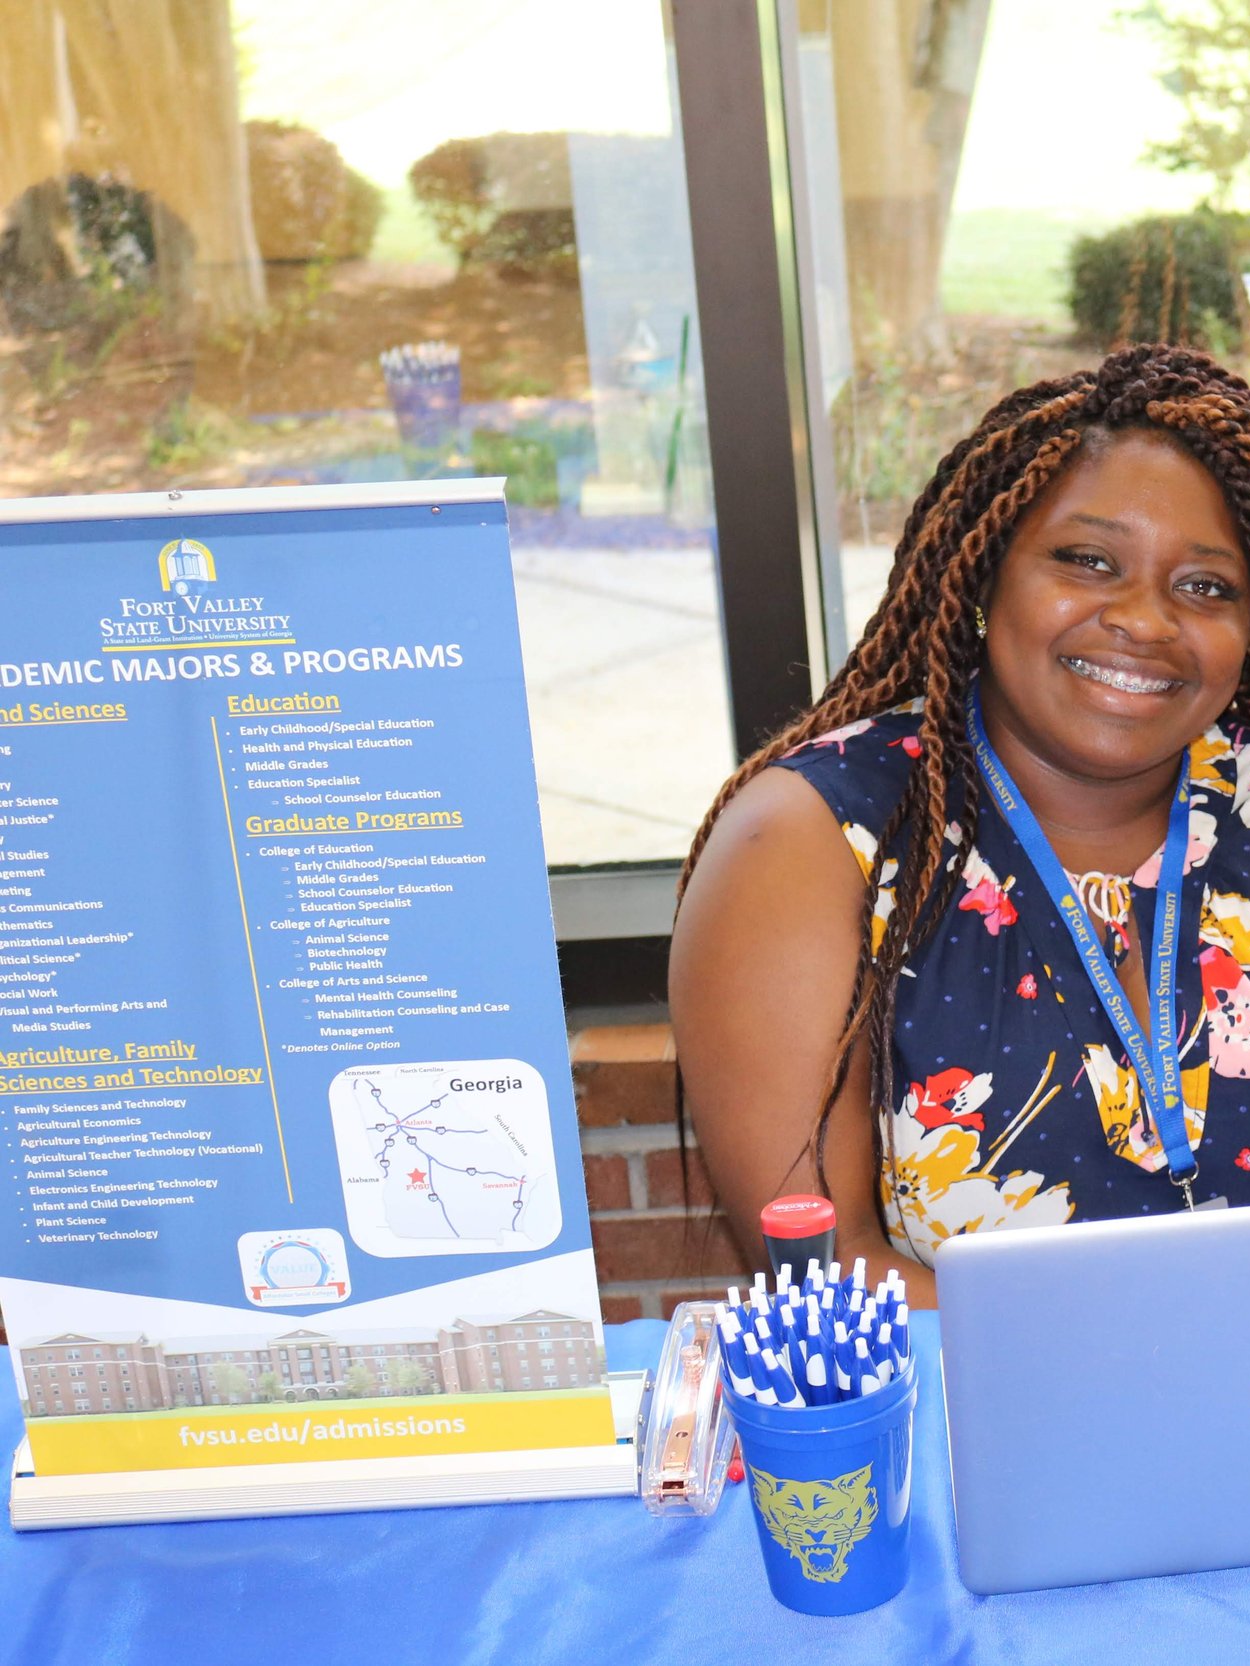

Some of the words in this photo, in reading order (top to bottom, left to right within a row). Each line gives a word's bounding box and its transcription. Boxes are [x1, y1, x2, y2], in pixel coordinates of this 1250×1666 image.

[120, 598, 176, 617] FORT
[181, 595, 264, 614] VALLEY
[100, 618, 161, 637] STATE
[165, 615, 290, 634] UNIVERSITY
[0, 659, 104, 688] DEMIC
[112, 653, 241, 682] MAJORS
[250, 652, 276, 676] &
[284, 643, 464, 674] PROGRAMS
[227, 692, 340, 714] Education
[0, 704, 23, 722] nd
[29, 702, 126, 721] Sciences
[240, 724, 269, 738] Early
[271, 720, 375, 735] Childhood/Special
[377, 717, 434, 730] Education
[242, 742, 281, 754] Health
[283, 741, 305, 752] and
[308, 739, 353, 753] Physical
[356, 737, 413, 749] Education
[245, 760, 285, 772] Middle
[288, 759, 329, 770] Grades
[248, 777, 304, 790] Education
[306, 775, 361, 788] Specialist
[976, 741, 1017, 811] UNIVERSITY
[16, 797, 59, 807] Science
[284, 793, 323, 805] School
[325, 791, 382, 803] Counselor
[385, 789, 441, 800] Education
[245, 813, 349, 834] Graduate
[356, 809, 463, 831] Programs
[8, 851, 49, 861] Studies
[259, 845, 301, 858] College
[303, 844, 316, 855] of
[318, 843, 374, 854] Education
[294, 860, 322, 872] Early
[325, 855, 427, 870] Childhood/Special
[430, 854, 486, 865] Education
[297, 873, 336, 885] Middle
[339, 872, 379, 883] Grades
[298, 887, 335, 899] School
[338, 885, 394, 897] Counselor
[398, 882, 453, 894] Education
[9, 901, 103, 913] Communications
[301, 901, 356, 913] Education
[358, 898, 412, 911] Specialist
[0, 920, 53, 931] thematics
[270, 918, 311, 931] College
[314, 917, 326, 928] of
[328, 915, 391, 929] Agriculture
[1158, 891, 1177, 958] UNIVERSITY
[0, 936, 64, 949] ganizational
[305, 933, 345, 945] Animal
[347, 931, 390, 943] Science
[0, 955, 30, 965] litical
[307, 946, 387, 959] Biotechnology
[309, 961, 343, 972] Public
[346, 959, 383, 970] Health
[1067, 908, 1090, 943] FORT
[1085, 944, 1114, 994] VALLEY
[1107, 995, 1132, 1034] STATE
[279, 977, 320, 989] College
[322, 976, 335, 987] of
[337, 975, 360, 986] Arts
[362, 974, 384, 985] and
[386, 973, 428, 984] Science
[1156, 960, 1171, 996] STATE
[0, 989, 25, 999] ocial
[28, 988, 58, 998] Work
[315, 991, 355, 1003] Mental
[357, 990, 394, 1001] Health
[396, 987, 458, 1002] Counseling
[32, 1005, 52, 1015] and
[56, 1002, 119, 1015] Performing
[121, 1001, 144, 1011] Arts
[146, 999, 167, 1009] and
[317, 1007, 395, 1020] Rehabilitation
[397, 1004, 458, 1018] Counseling
[460, 1003, 482, 1014] and
[484, 1002, 510, 1013] Case
[12, 1023, 47, 1033] Media
[50, 1021, 91, 1032] Studies
[320, 1025, 394, 1038] Management
[1158, 1000, 1172, 1052] VALLEY
[124, 1040, 196, 1061] Family
[331, 1041, 363, 1052] Online
[366, 1040, 401, 1052] Option
[0, 1074, 88, 1092] Sciences
[94, 1068, 134, 1089] and
[139, 1065, 262, 1087] Technology
[1163, 1055, 1177, 1093] FORT
[450, 1076, 523, 1093] Georgia
[14, 1105, 50, 1116] Family
[52, 1102, 99, 1113] Sciences
[101, 1101, 122, 1111] and
[124, 1098, 186, 1111] Technology
[17, 1119, 81, 1132] Agricultural
[83, 1116, 141, 1128] Economics
[20, 1136, 81, 1149] Agriculture
[84, 1132, 148, 1146] Engineering
[150, 1129, 212, 1142] Technology
[23, 1151, 87, 1165] Agricultural
[89, 1150, 132, 1160] Teacher
[134, 1146, 196, 1159] Technology
[198, 1143, 263, 1157] (Vocational)
[26, 1168, 65, 1180] Animal
[67, 1167, 108, 1178] Science
[29, 1183, 88, 1196] Electronics
[90, 1181, 155, 1194] Engineering
[157, 1177, 218, 1191] Technology
[32, 1200, 65, 1212] Infant
[67, 1199, 88, 1210] and
[90, 1197, 118, 1209] Child
[121, 1194, 194, 1209] Development
[35, 1216, 64, 1227] Plant
[66, 1215, 107, 1226] Science
[38, 1231, 95, 1245] Veterinary
[97, 1229, 158, 1242] Technology
[179, 1416, 466, 1446] fvsu.edu/admissions
